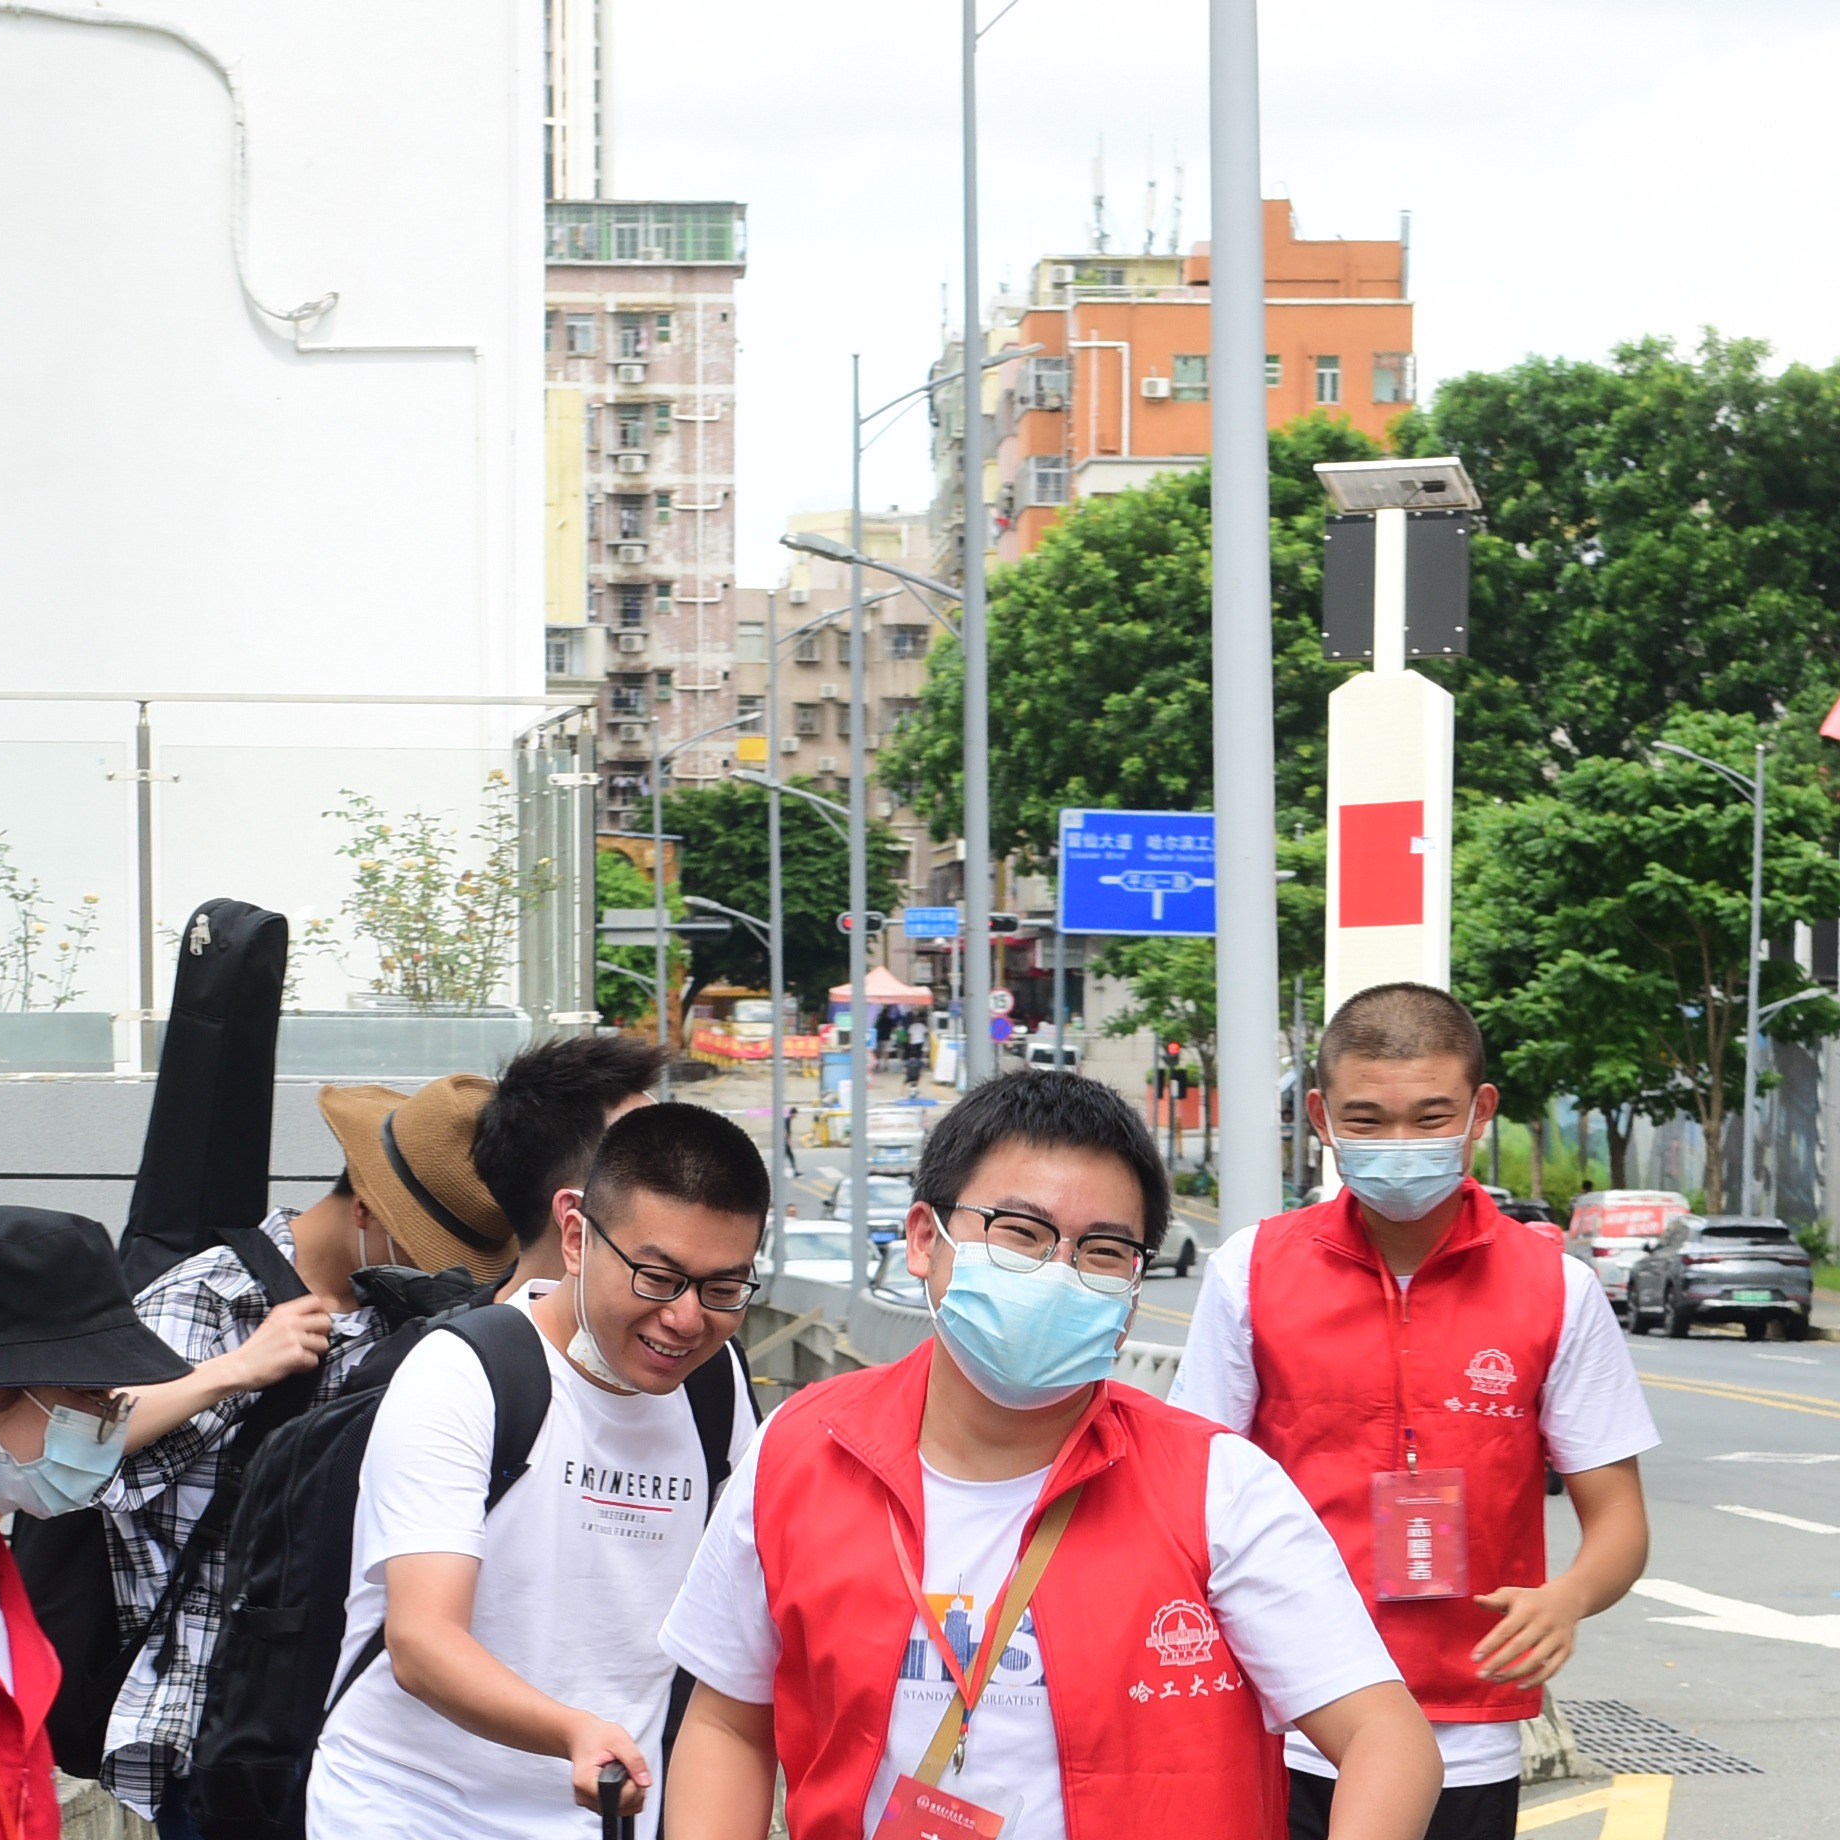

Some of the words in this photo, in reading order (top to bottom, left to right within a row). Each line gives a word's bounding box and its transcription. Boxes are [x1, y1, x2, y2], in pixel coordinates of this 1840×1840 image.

[1145, 834, 1215, 851] 哈尔滨工
[1128, 1671, 1244, 1704] 哈工大义
[980, 1693, 1042, 1707] GREATEST
